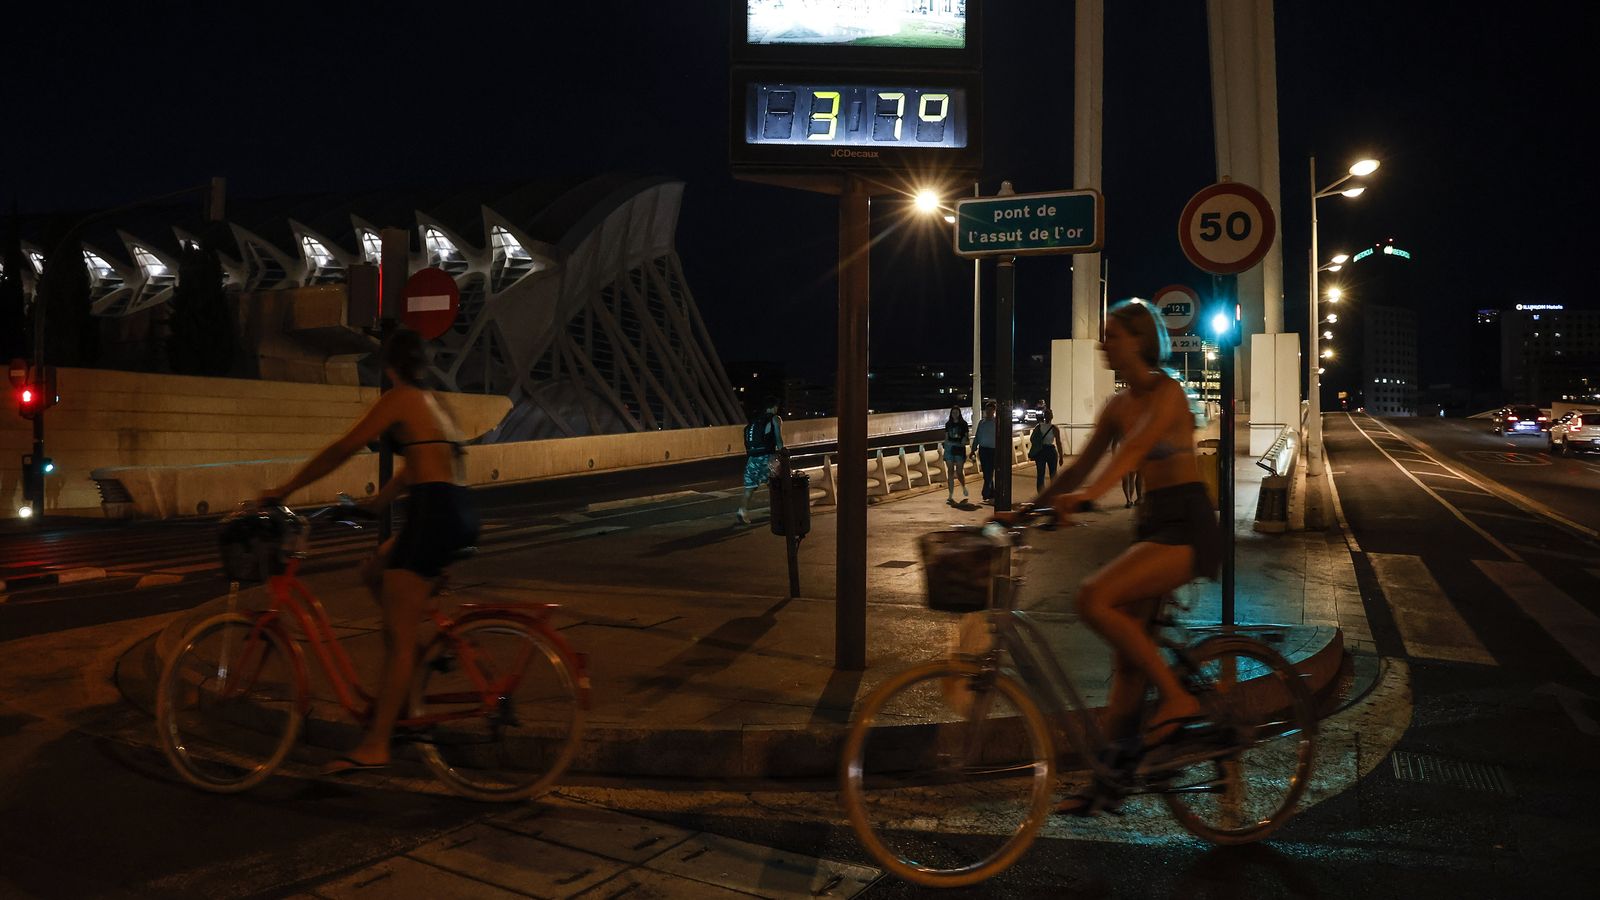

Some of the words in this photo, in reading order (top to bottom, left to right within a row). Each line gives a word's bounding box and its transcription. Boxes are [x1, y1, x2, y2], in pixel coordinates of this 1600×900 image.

[831, 148, 880, 159] JCDecaux
[994, 205, 1031, 223] pont
[1036, 204, 1057, 217] de
[968, 228, 1023, 244] l'assut
[1029, 228, 1049, 240] de
[1054, 226, 1083, 239] l'or
[1200, 211, 1252, 242] 50
